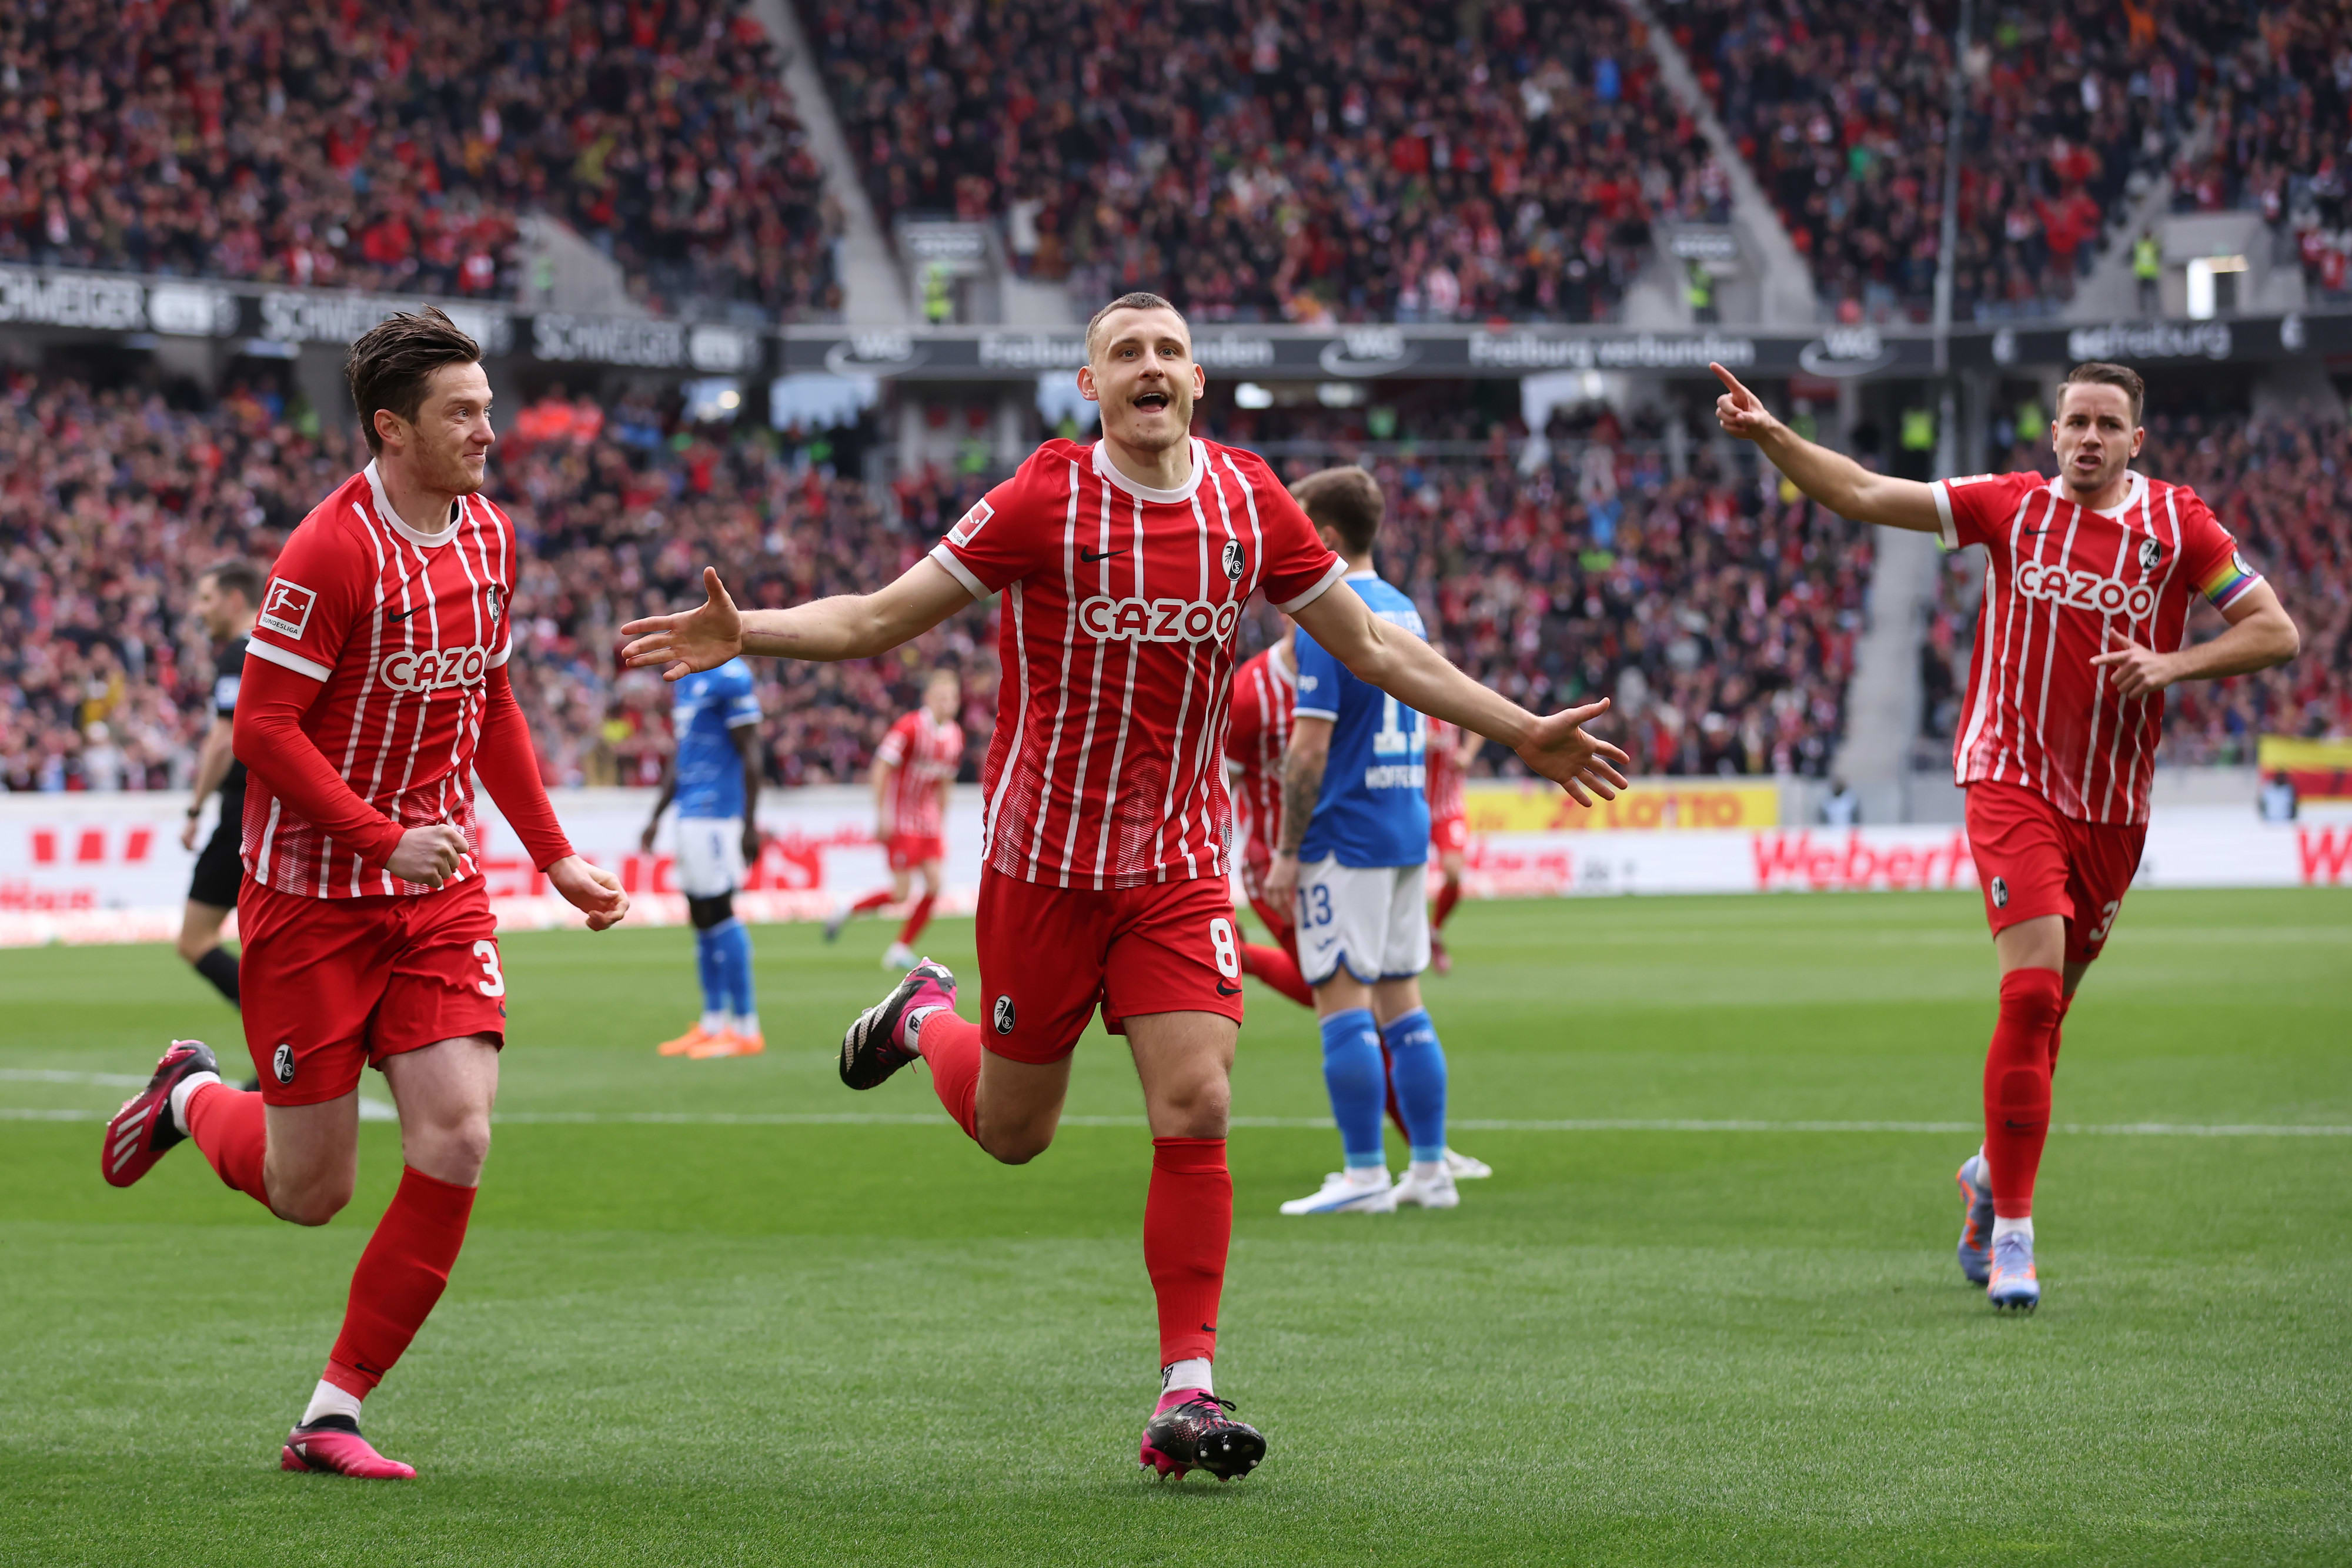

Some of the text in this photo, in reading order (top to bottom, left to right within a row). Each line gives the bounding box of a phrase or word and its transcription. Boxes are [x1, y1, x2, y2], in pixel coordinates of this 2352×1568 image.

[2017, 560, 2154, 620] CAZOO
[262, 616, 298, 634] BUNDESLIGA
[1078, 596, 1239, 642] CAZOO
[380, 645, 489, 693] CAZO
[1297, 884, 1333, 929] 13
[473, 940, 505, 997] 3
[1210, 918, 1239, 978] 8
